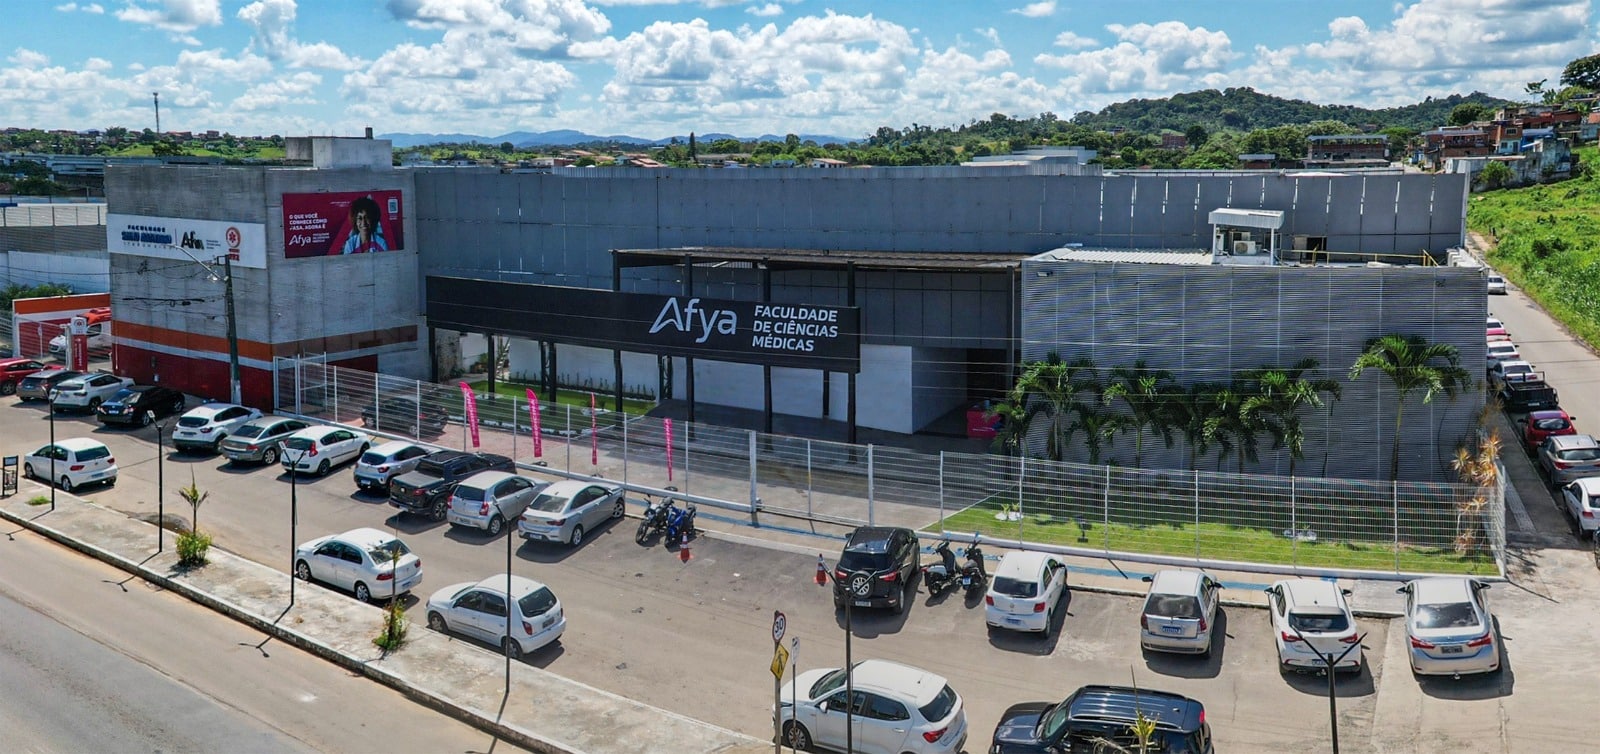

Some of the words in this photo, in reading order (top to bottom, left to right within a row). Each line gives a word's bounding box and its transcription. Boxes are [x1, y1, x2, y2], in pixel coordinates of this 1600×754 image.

[288, 234, 312, 247] Afya
[648, 297, 738, 343] Afya
[754, 305, 839, 322] FACULDADE
[753, 320, 771, 333] DE
[773, 320, 839, 338] CIÊNCIAS
[752, 334, 815, 351] MÉDICAS
[775, 618, 784, 633] 30
